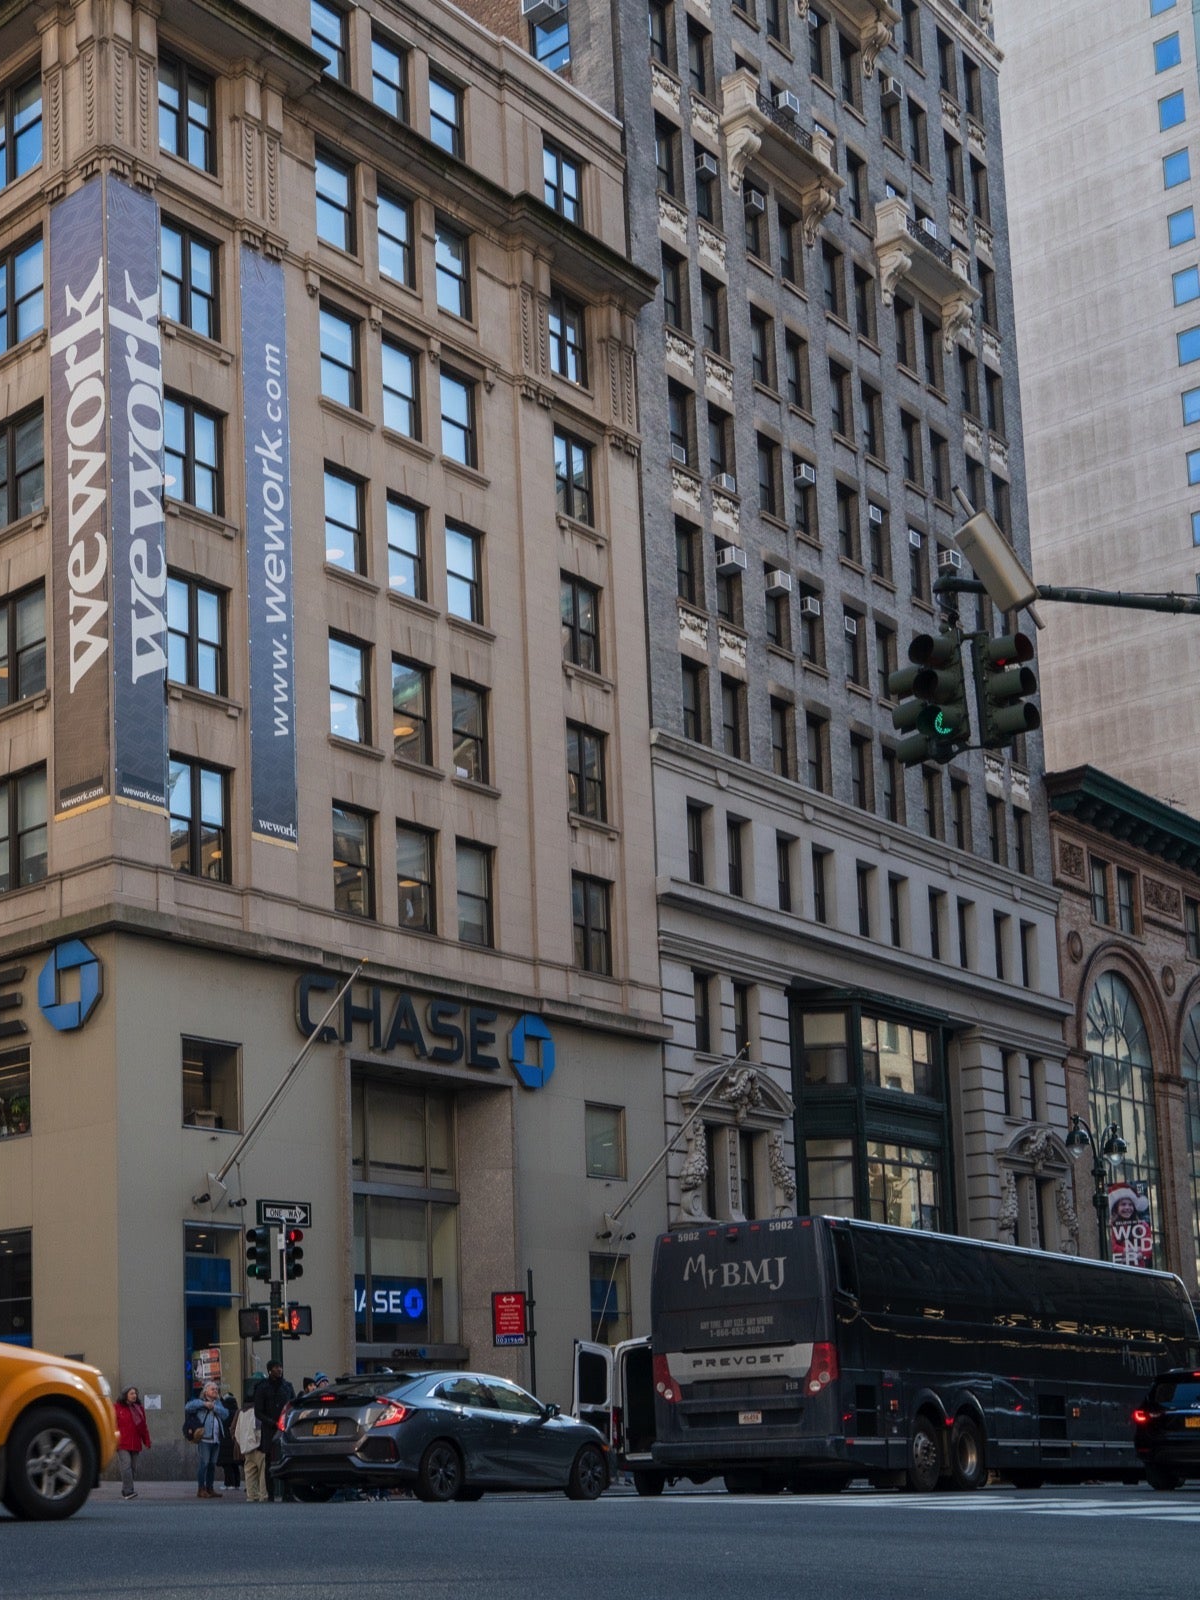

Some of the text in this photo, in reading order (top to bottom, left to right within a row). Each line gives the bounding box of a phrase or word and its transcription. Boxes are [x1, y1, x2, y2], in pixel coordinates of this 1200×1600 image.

[50, 256, 109, 694] wework
[108, 269, 168, 685] wework
[61, 786, 104, 809] wework.com
[259, 819, 297, 838] wework
[295, 973, 501, 1070] CHASE
[270, 1210, 301, 1219] ONE WAY
[769, 1221, 793, 1231] 5902
[1113, 1225, 1147, 1240] WO
[678, 1232, 699, 1242] 5902
[1125, 1238, 1153, 1252] ND
[692, 1353, 784, 1369] PREVOST
